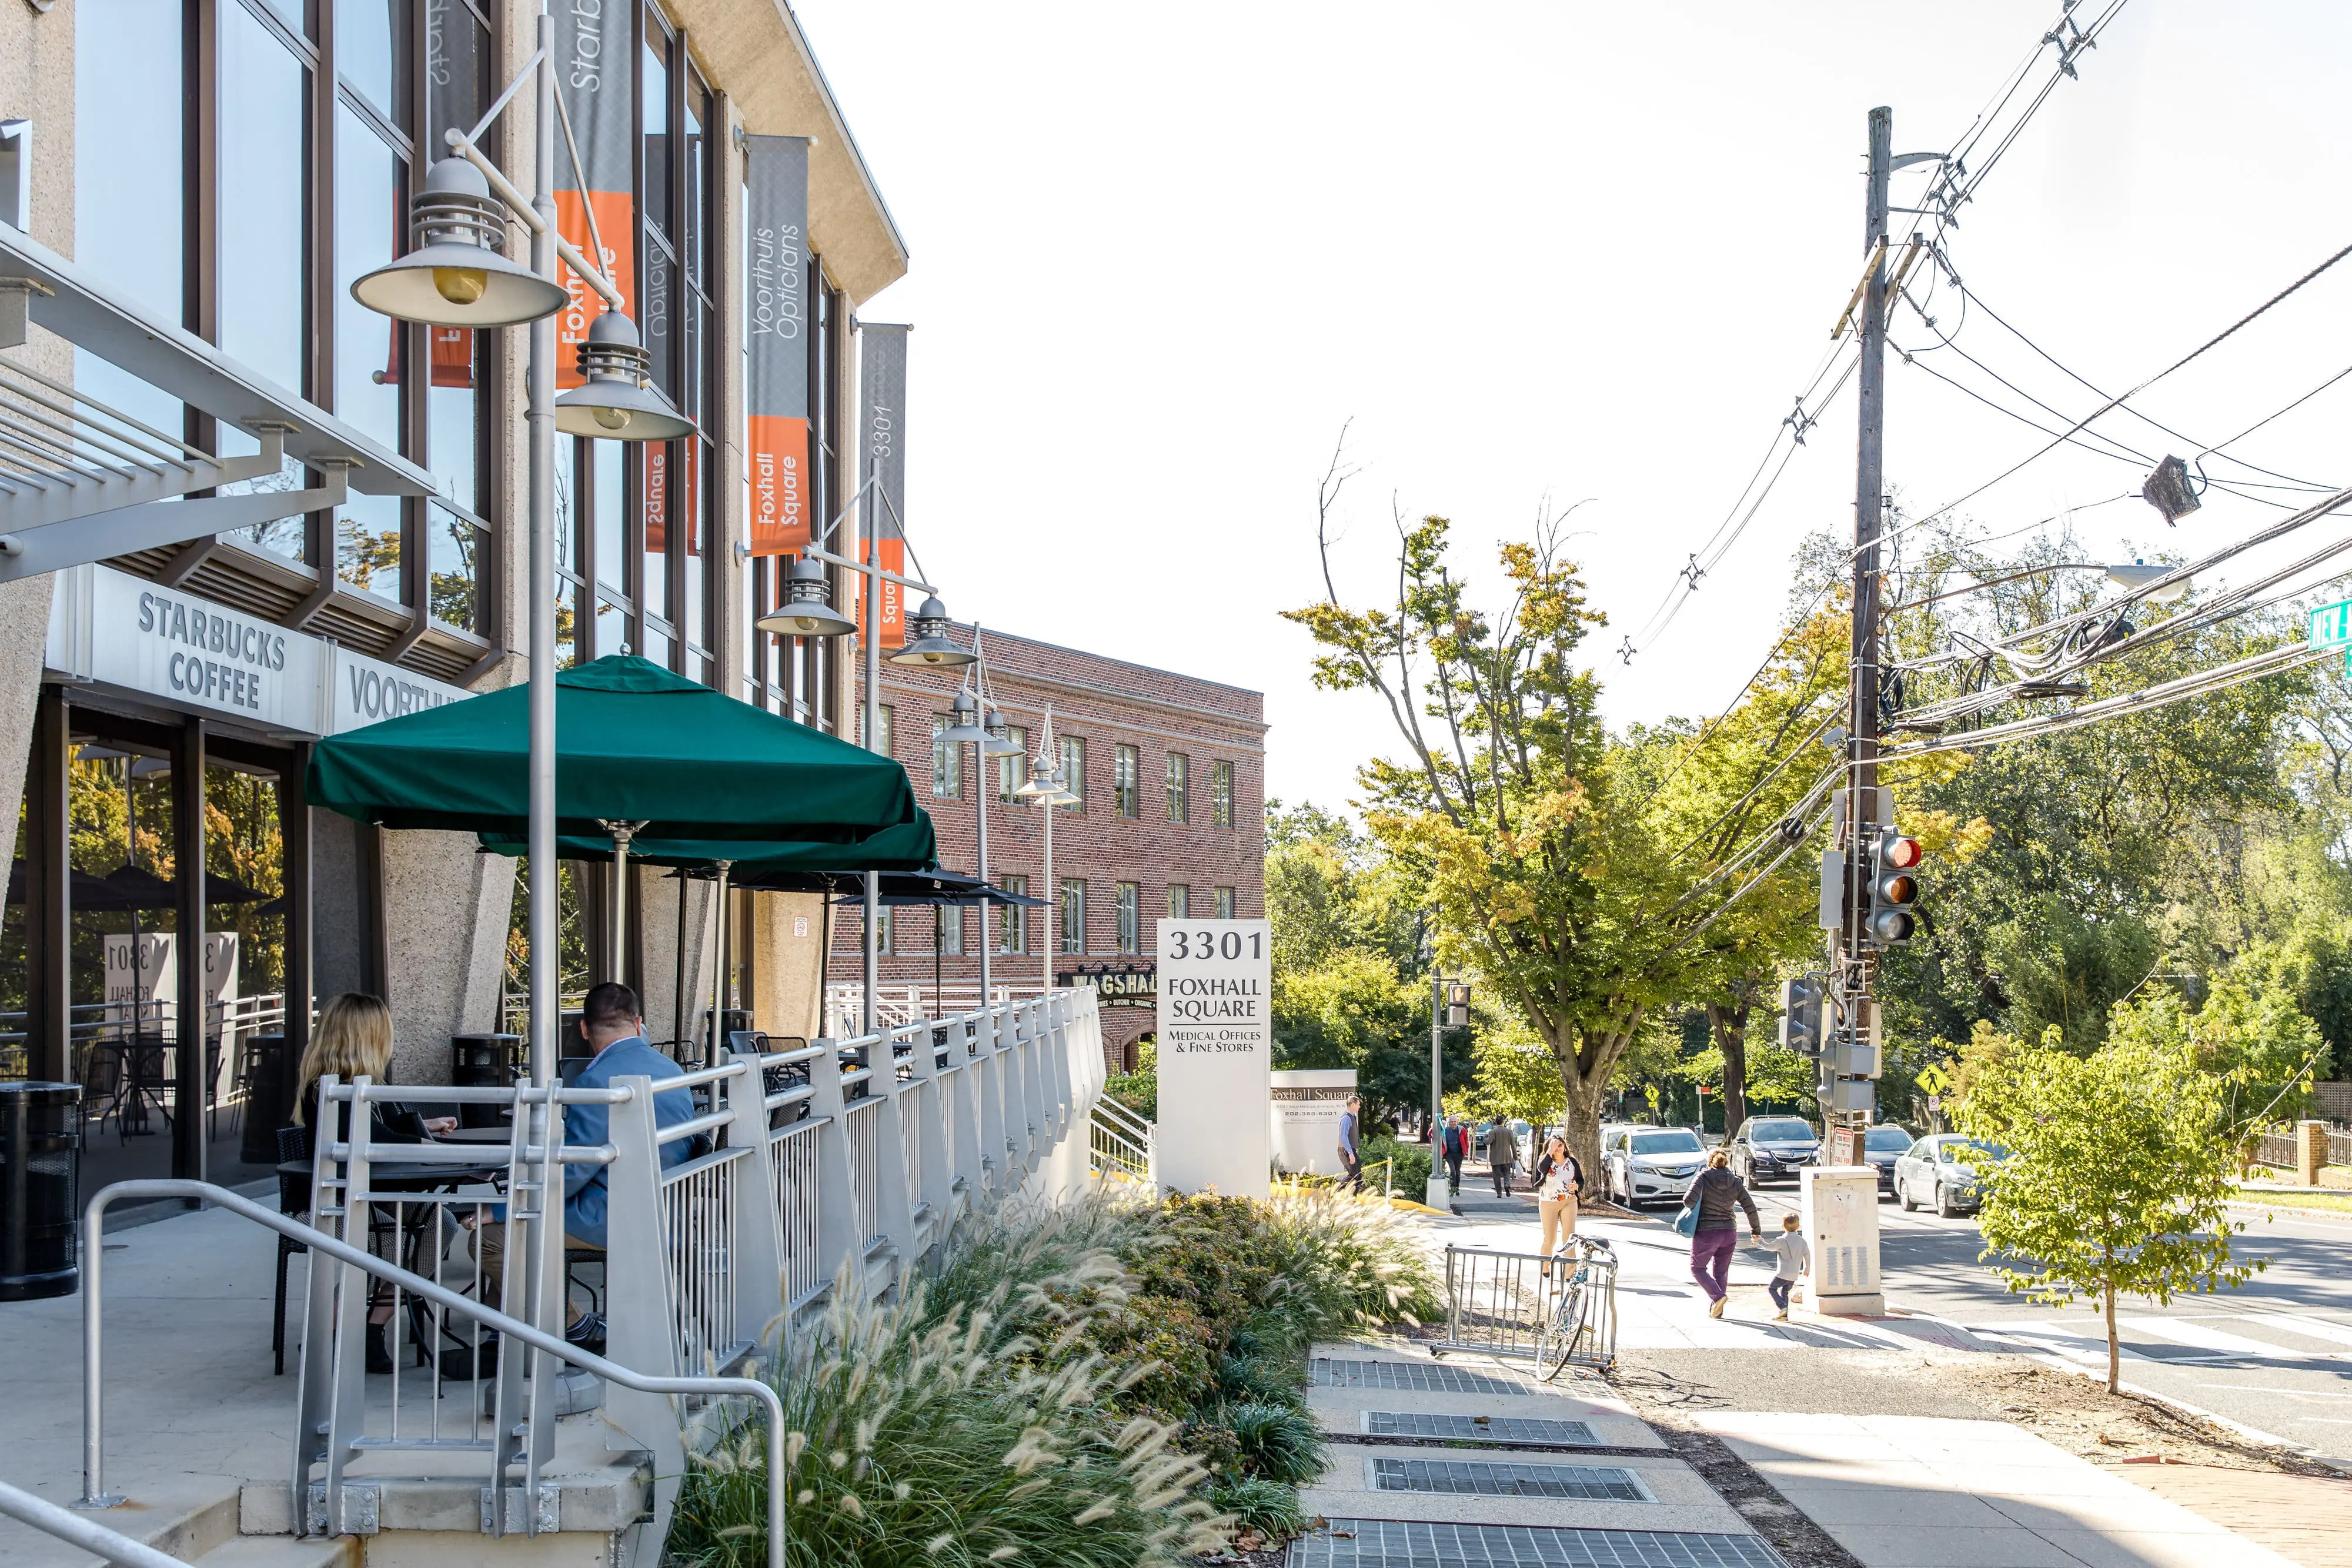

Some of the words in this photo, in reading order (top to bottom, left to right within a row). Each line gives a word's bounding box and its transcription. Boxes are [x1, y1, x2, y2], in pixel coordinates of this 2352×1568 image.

[753, 228, 774, 334] Voorthuis
[776, 225, 802, 339] Opticians
[873, 406, 891, 457] 3301
[756, 453, 775, 524] Foxhall
[781, 456, 801, 525] Square
[139, 592, 284, 671] STARBUCKS
[2312, 606, 2341, 646] NEW
[169, 652, 259, 710] COFFEE
[1170, 931, 1261, 959] 3301
[1169, 978, 1261, 996] FOXHALL
[1173, 1000, 1256, 1022] SQUARE
[1169, 1030, 1215, 1041] MEDICAL
[1220, 1029, 1261, 1040] OFFICES
[1176, 1042, 1185, 1052] &
[1190, 1042, 1212, 1052] FINE
[1216, 1042, 1254, 1052] STORES
[1271, 1088, 1311, 1100] Foxhall
[1315, 1088, 1355, 1100] Square
